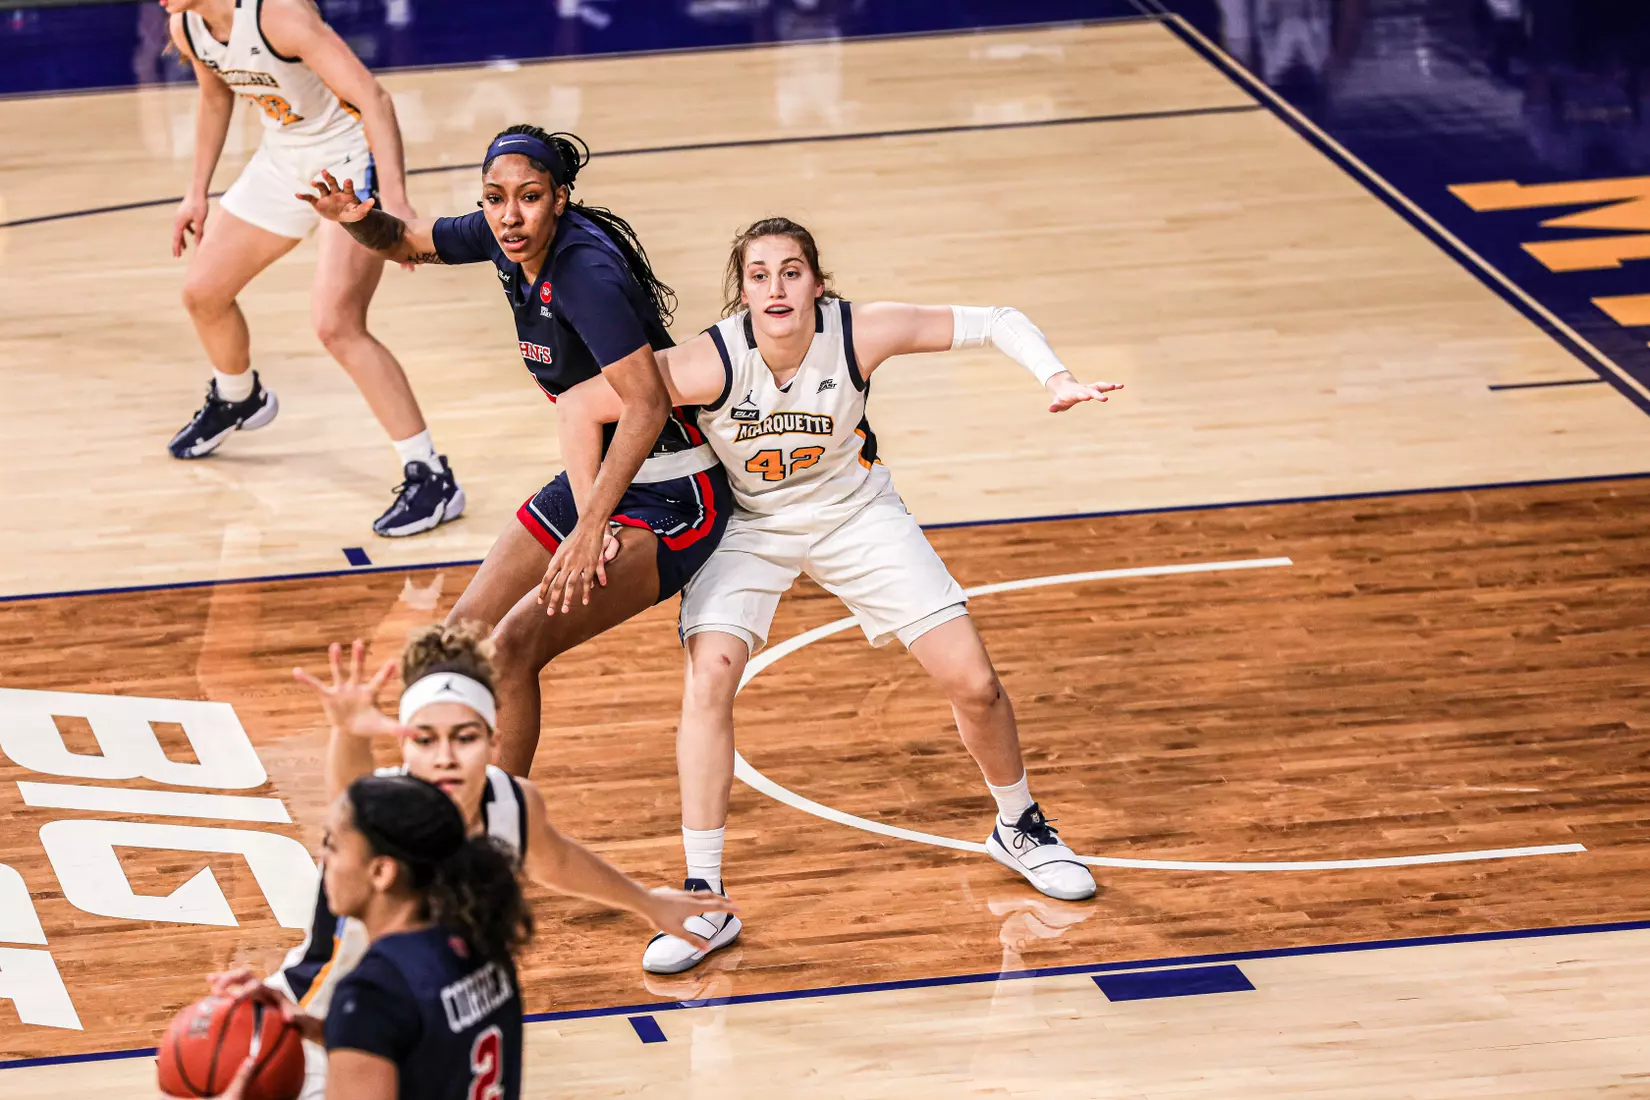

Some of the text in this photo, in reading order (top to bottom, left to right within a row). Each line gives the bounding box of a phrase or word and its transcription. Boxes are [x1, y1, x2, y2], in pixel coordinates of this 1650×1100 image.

[817, 383, 837, 393] EAST
[819, 379, 834, 387] BIG
[745, 446, 825, 481] 42
[0, 688, 322, 929] BIG
[467, 1025, 505, 1100] 2
